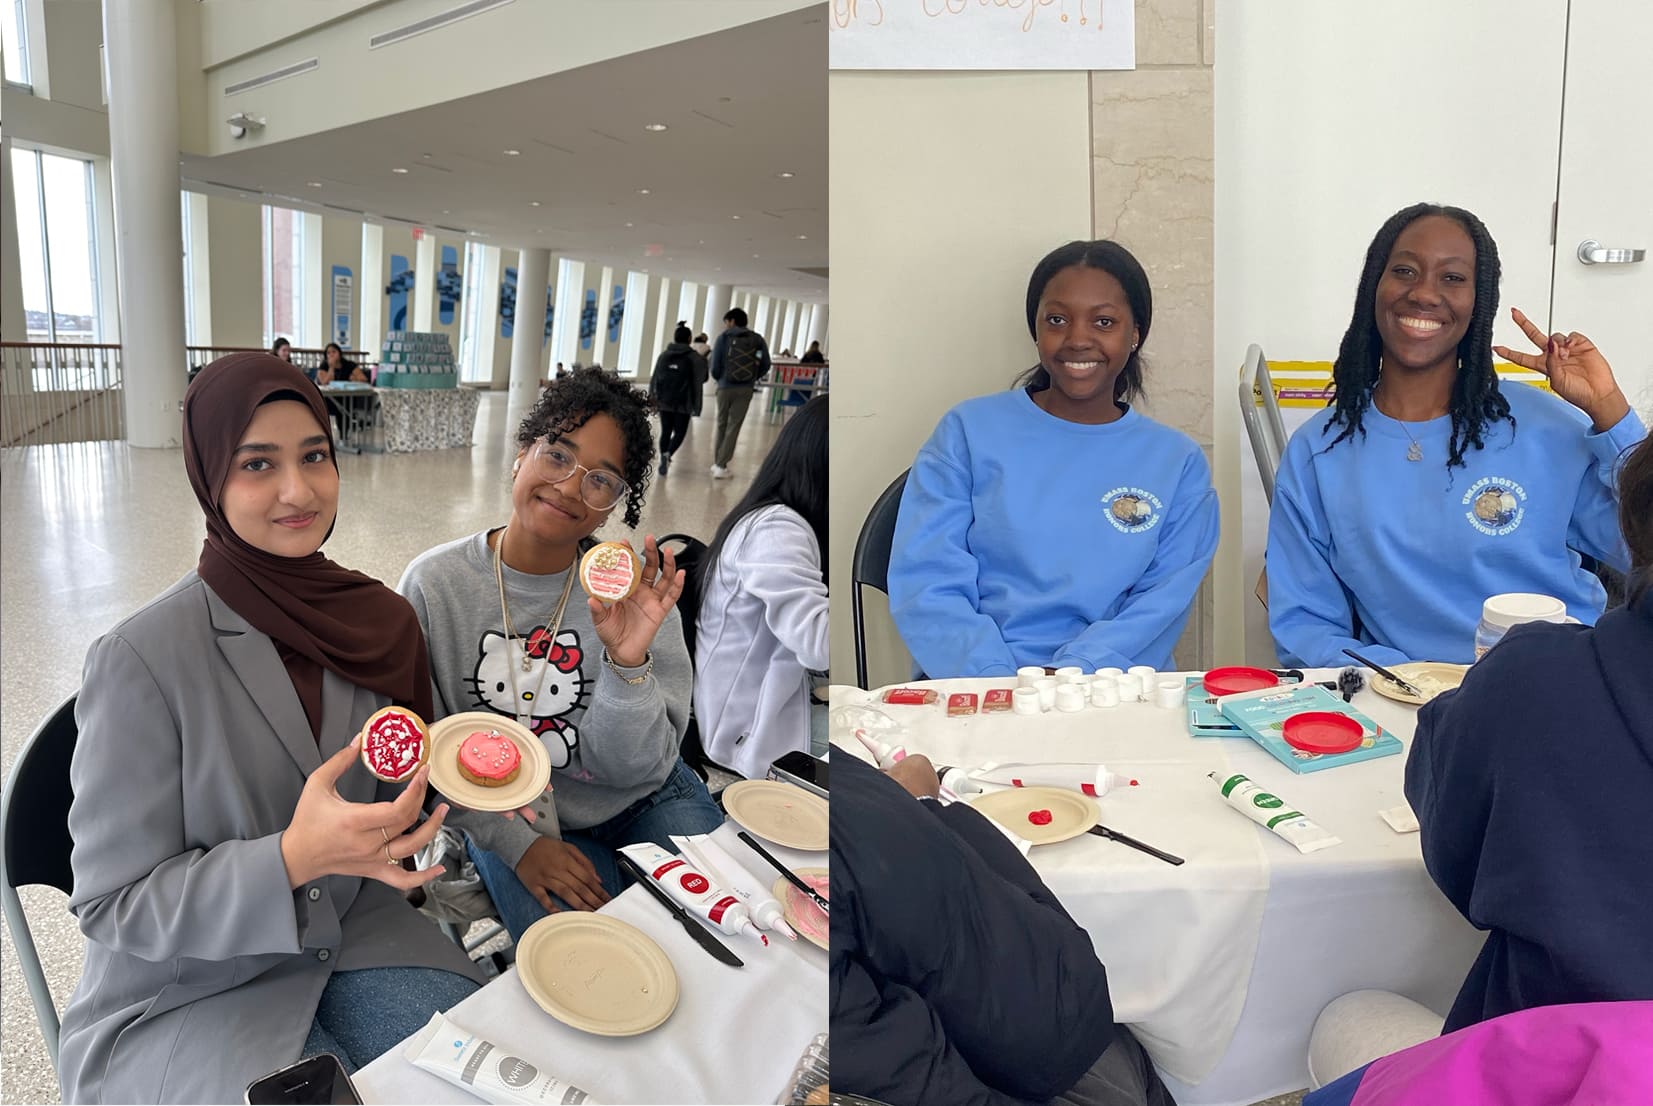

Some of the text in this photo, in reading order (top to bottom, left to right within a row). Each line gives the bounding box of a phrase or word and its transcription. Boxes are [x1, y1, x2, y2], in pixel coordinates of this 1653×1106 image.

[1130, 487, 1163, 509] BOSTON
[1461, 476, 1528, 505] UMASS BOSTON
[1103, 508, 1161, 534] HONORS COLLEGE
[1465, 507, 1526, 536] HONORS COLLEGE
[687, 878, 702, 889] RED
[506, 1059, 530, 1084] WHITE
